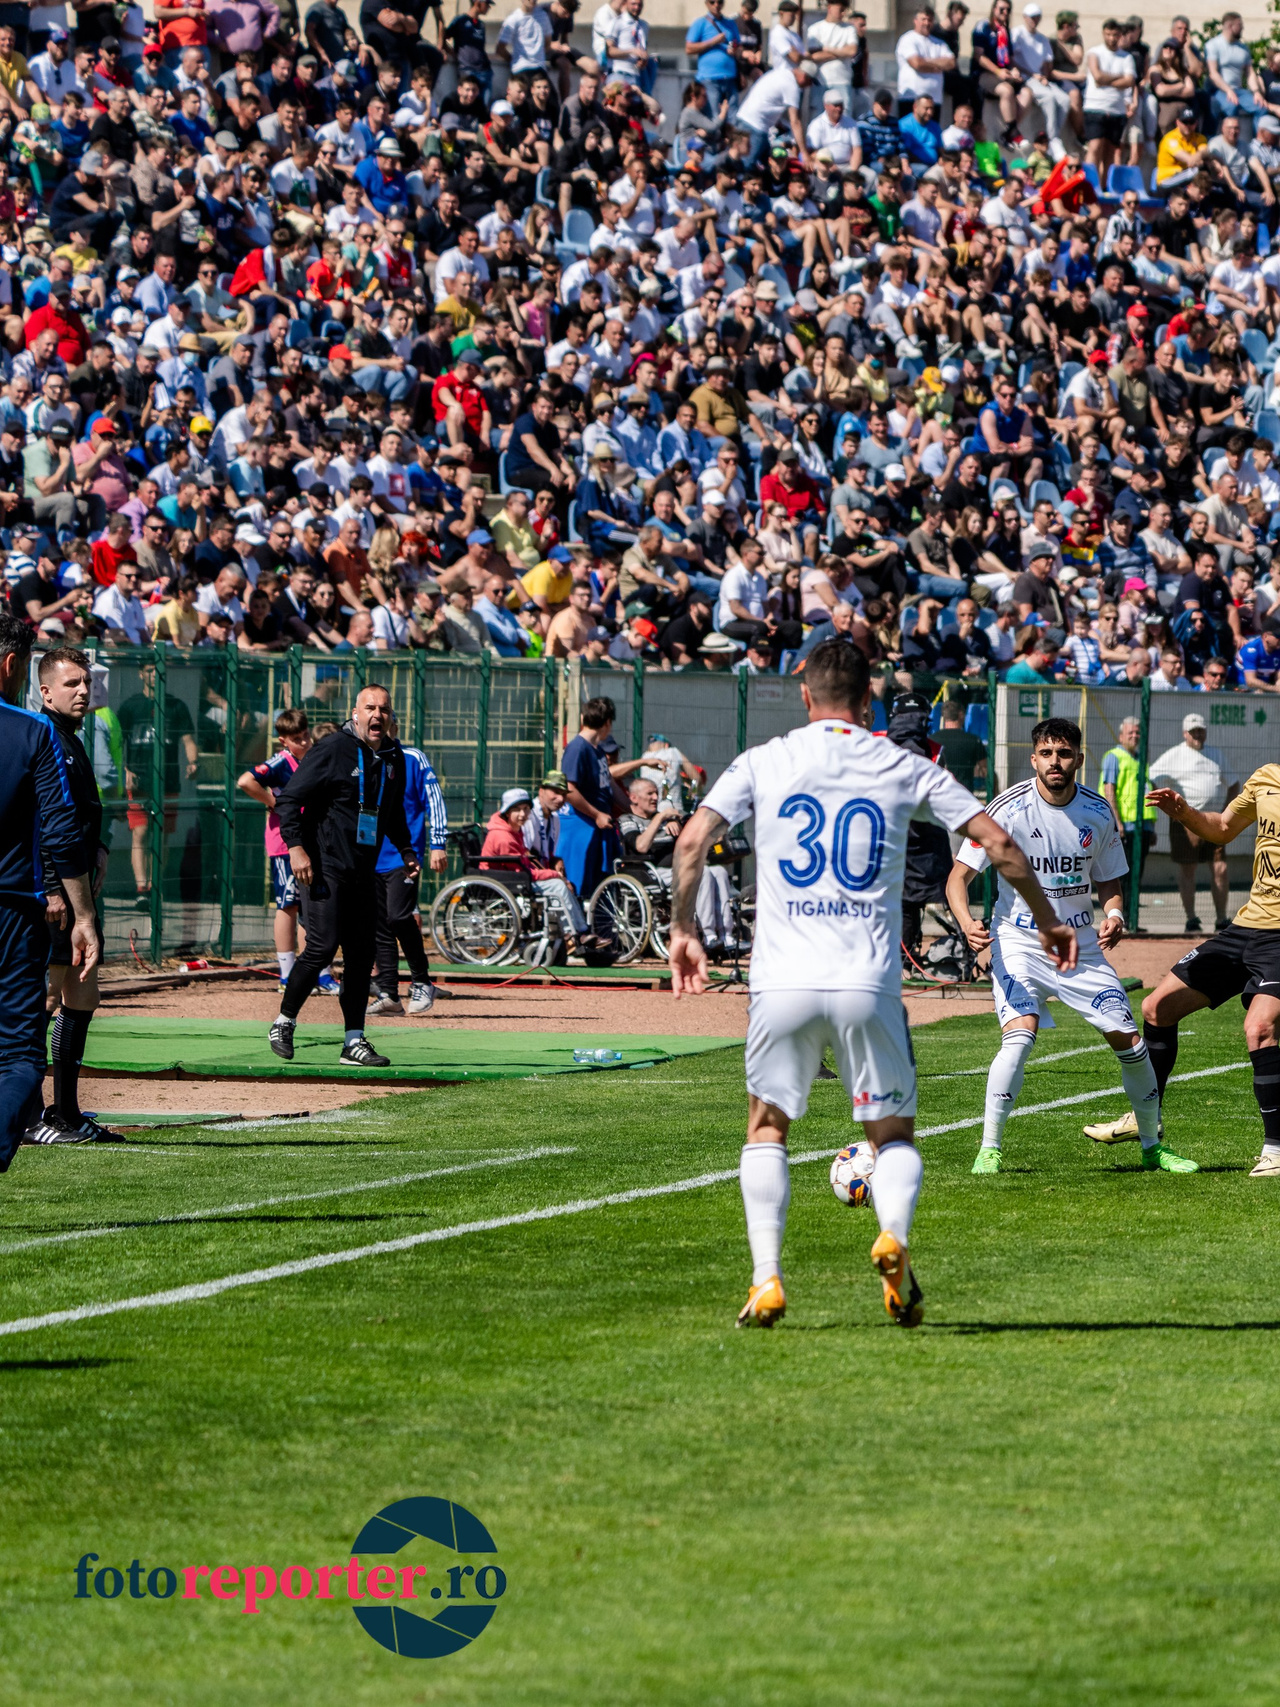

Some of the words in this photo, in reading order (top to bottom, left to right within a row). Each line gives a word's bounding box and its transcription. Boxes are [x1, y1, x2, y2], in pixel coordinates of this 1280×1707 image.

[1210, 704, 1246, 726] IESIRE
[778, 793, 885, 891] 30
[1016, 911, 1091, 929] ELACO
